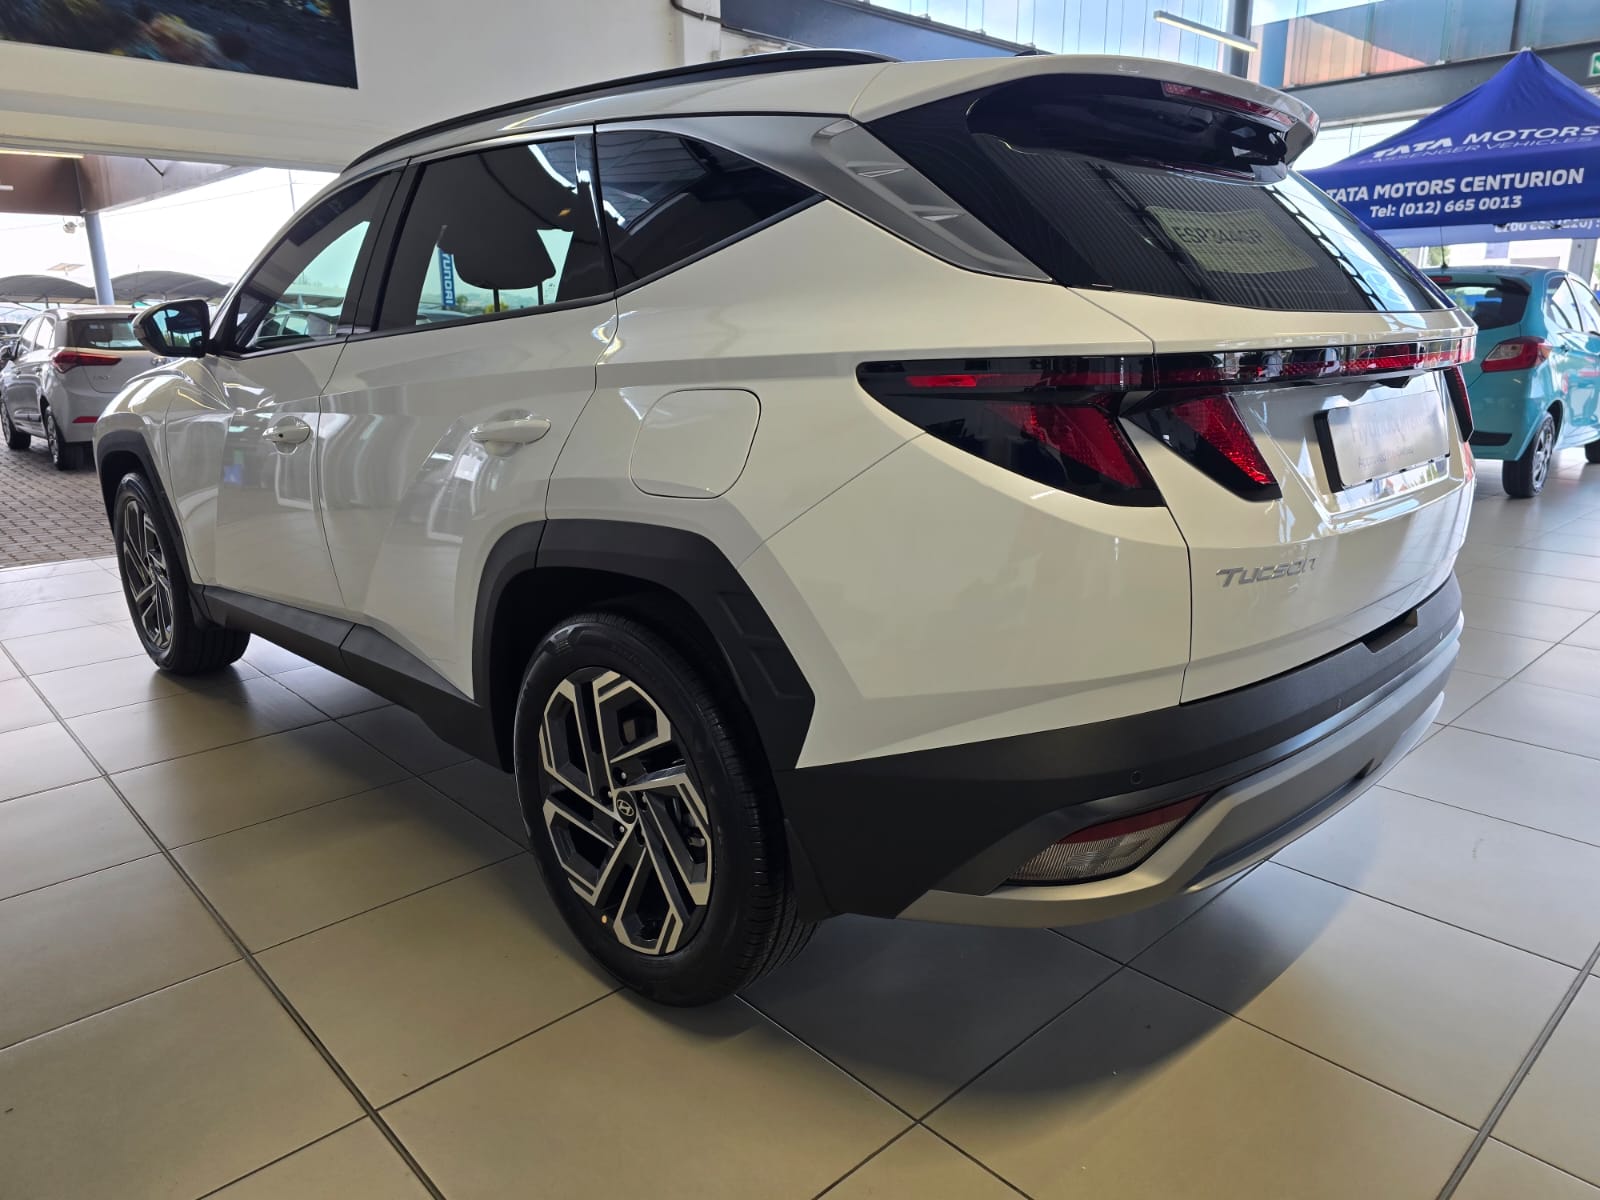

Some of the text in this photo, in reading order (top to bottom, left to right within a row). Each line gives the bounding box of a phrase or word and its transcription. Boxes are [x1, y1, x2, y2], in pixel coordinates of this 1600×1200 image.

[1373, 125, 1600, 159] TATA MOTORS
[1486, 136, 1594, 150] VEHICLES
[1325, 167, 1585, 203] TATA MOTORS CENTURION
[1369, 195, 1522, 218] Tel: (012) 665 0013
[442, 253, 455, 304] YUNDAI
